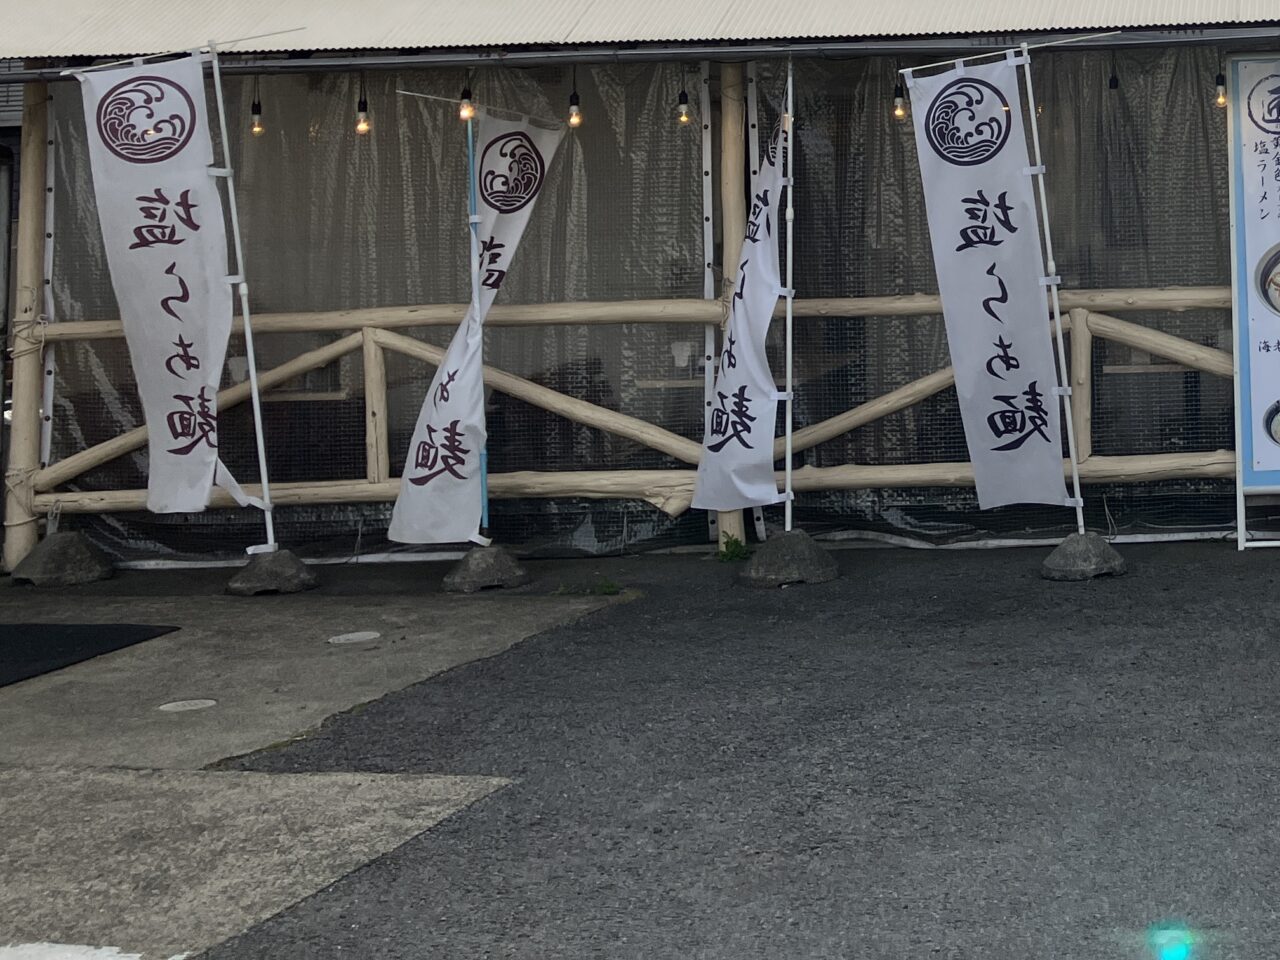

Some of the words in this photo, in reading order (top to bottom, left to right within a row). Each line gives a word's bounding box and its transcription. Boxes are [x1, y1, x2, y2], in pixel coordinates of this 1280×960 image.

[1254, 140, 1271, 220] 塩ラーメン
